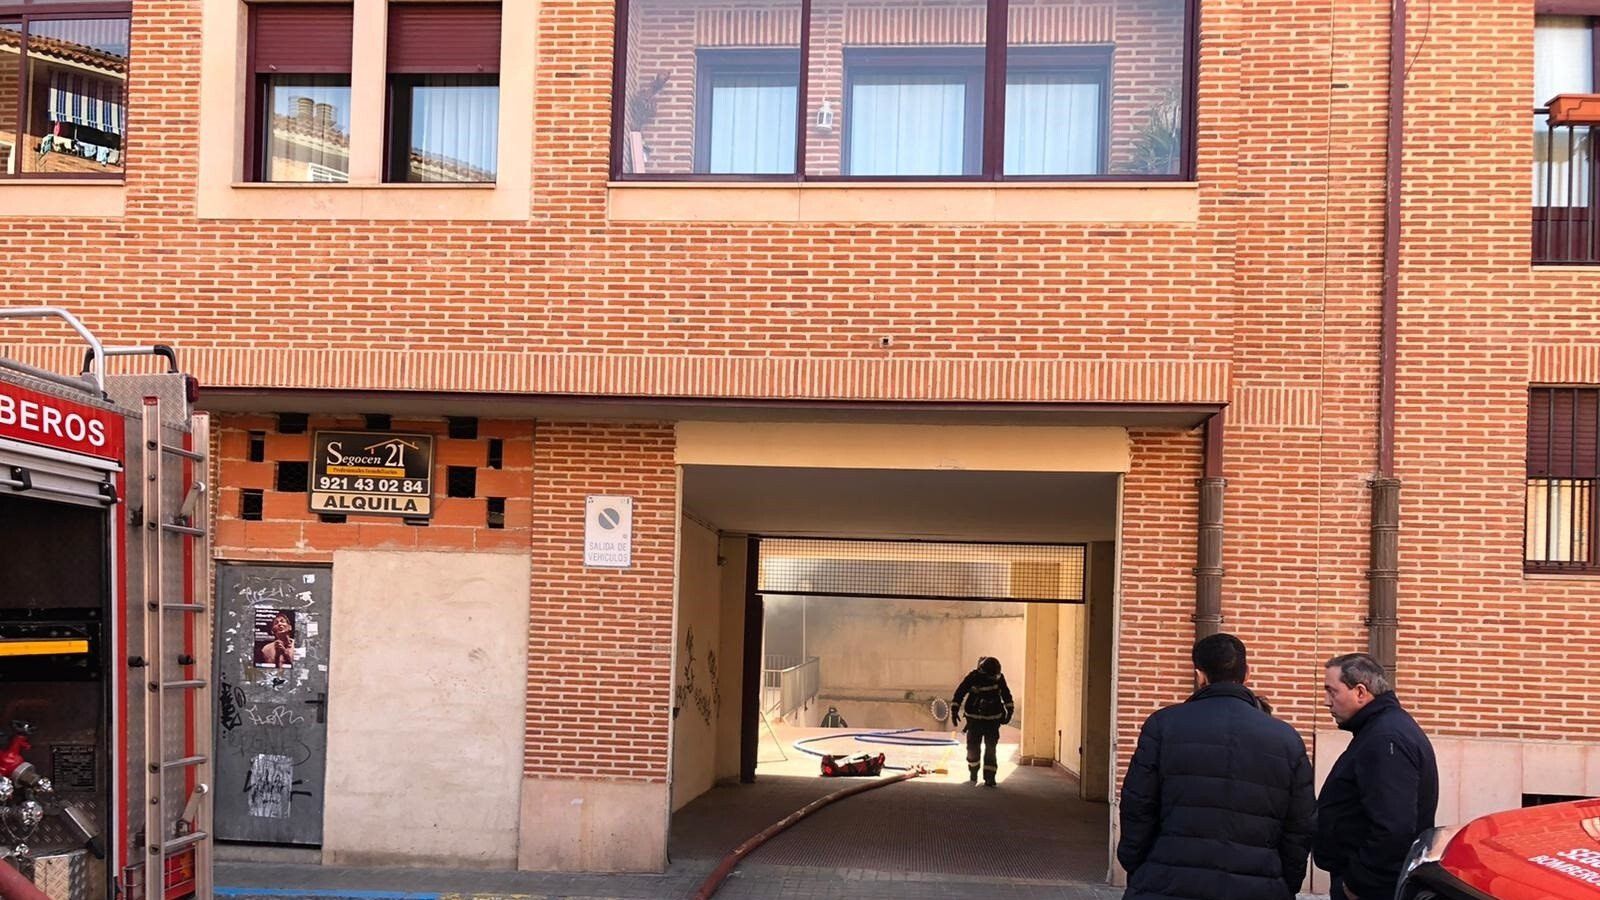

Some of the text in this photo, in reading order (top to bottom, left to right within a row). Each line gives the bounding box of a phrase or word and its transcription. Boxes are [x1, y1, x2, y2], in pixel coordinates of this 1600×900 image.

[0, 394, 105, 447] BEROS
[326, 441, 405, 467] Segocen 21
[320, 477, 423, 493] 921 43 02 84
[323, 495, 418, 512] ALQUILA
[589, 542, 627, 552] SALIDA DE
[1527, 854, 1600, 887] BOMBERO
